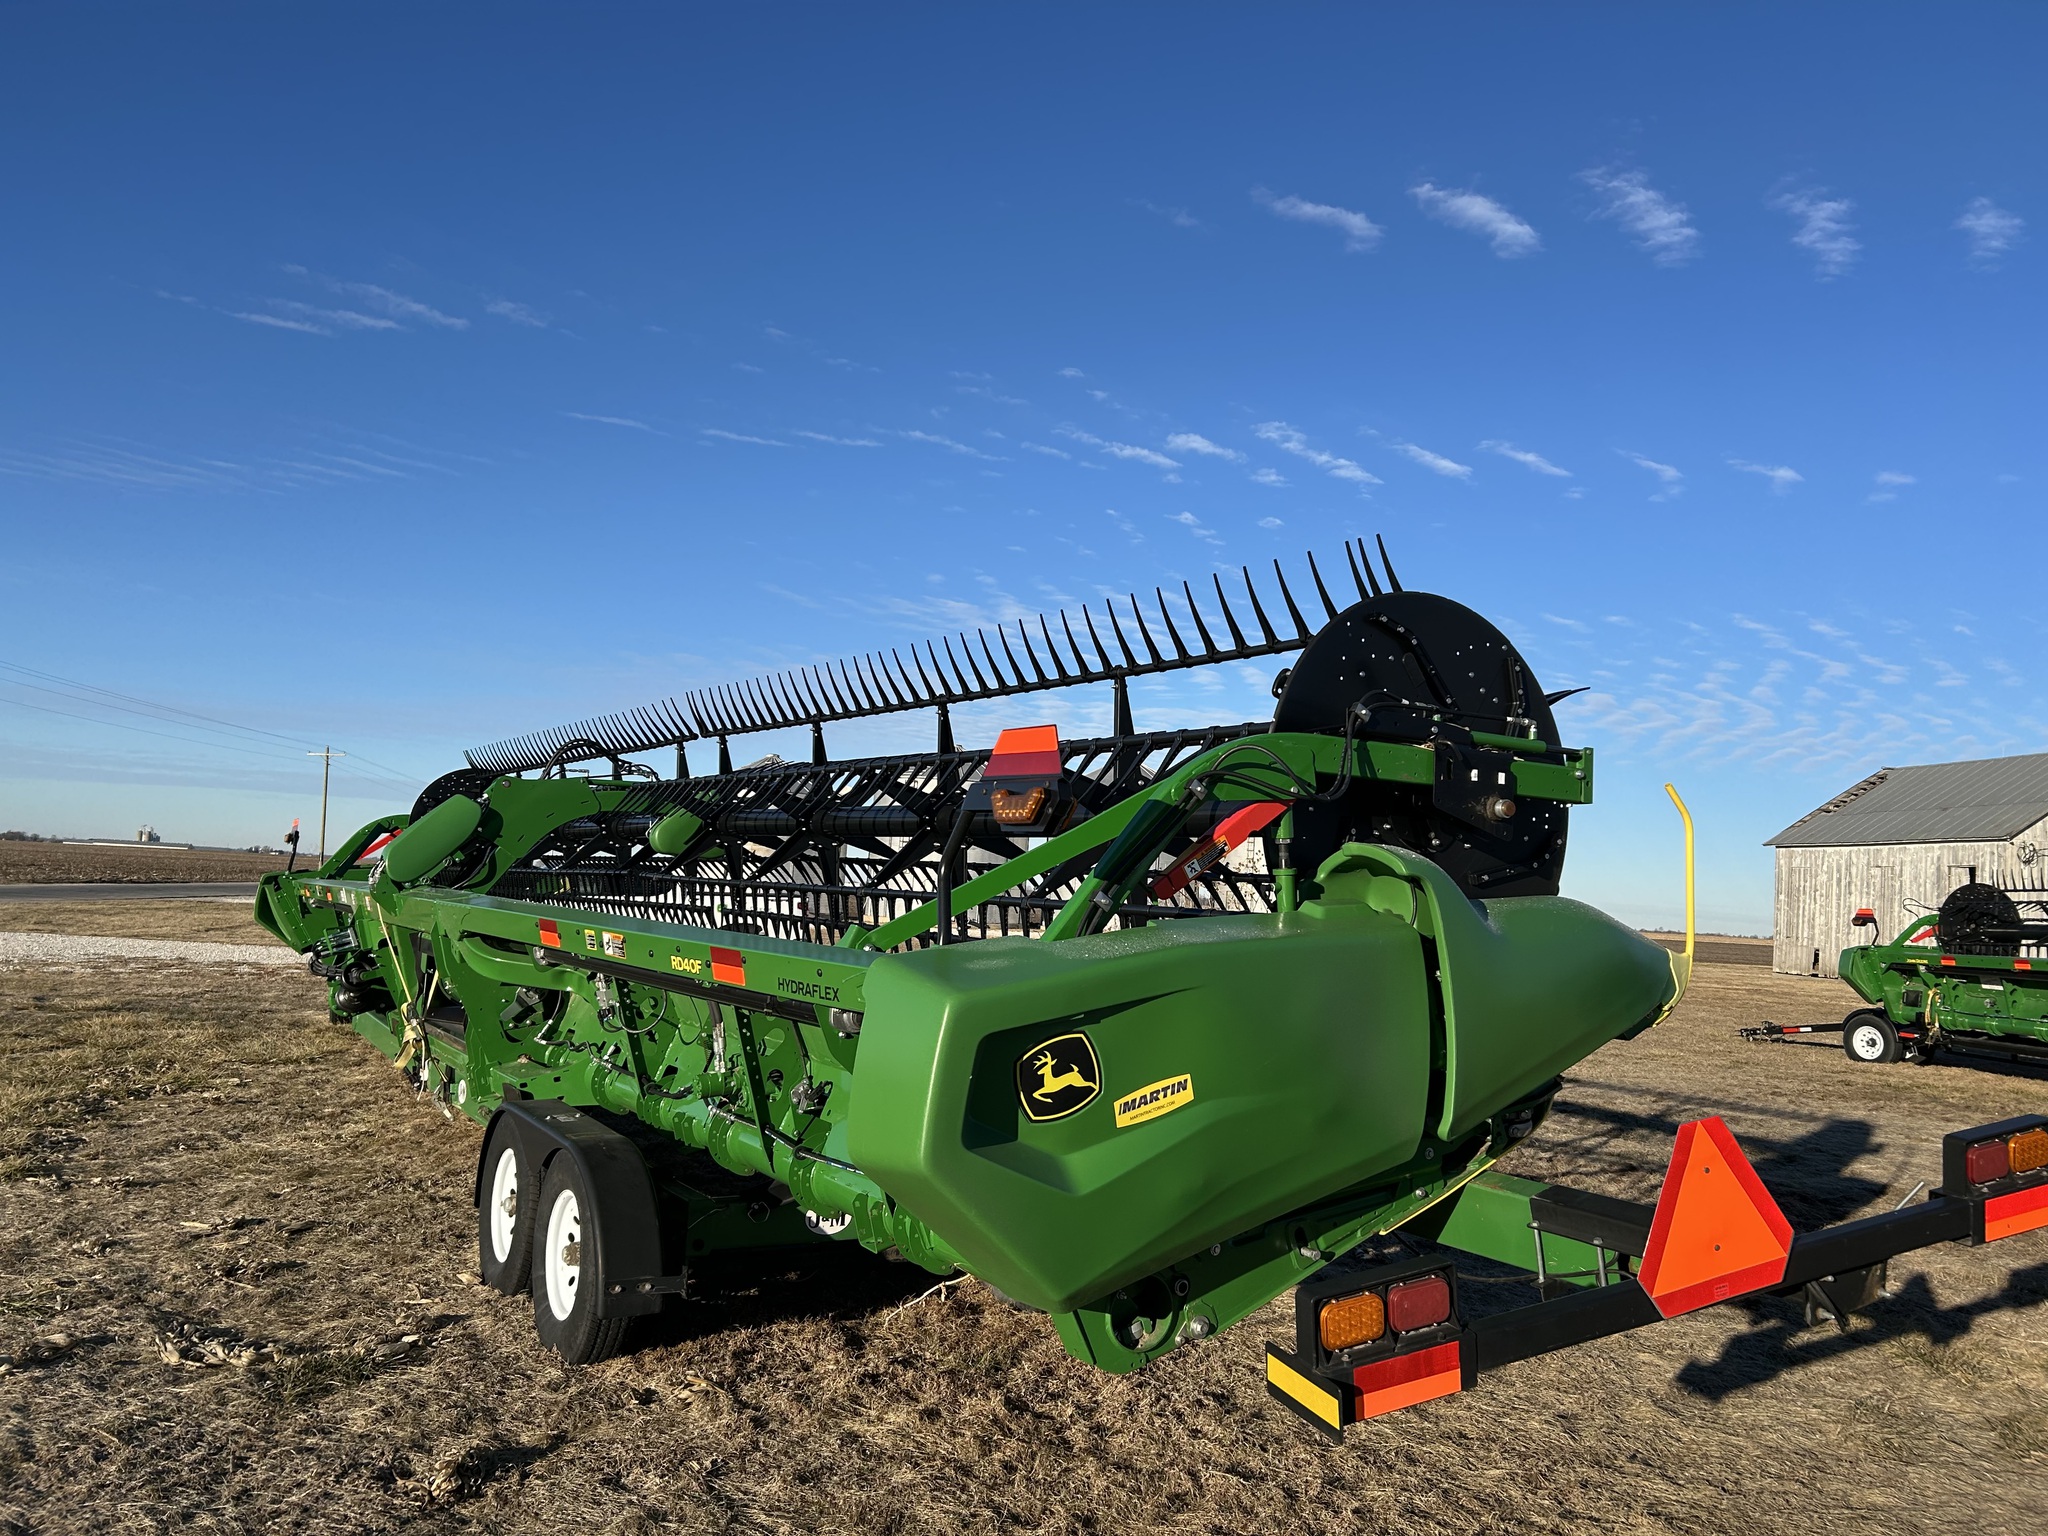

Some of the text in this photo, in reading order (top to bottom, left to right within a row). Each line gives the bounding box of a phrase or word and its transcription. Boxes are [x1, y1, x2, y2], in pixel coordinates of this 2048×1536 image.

[670, 955, 702, 975] RD40F
[777, 977, 841, 1003] HYDRAFLEX
[1120, 1078, 1188, 1115] MARTIN
